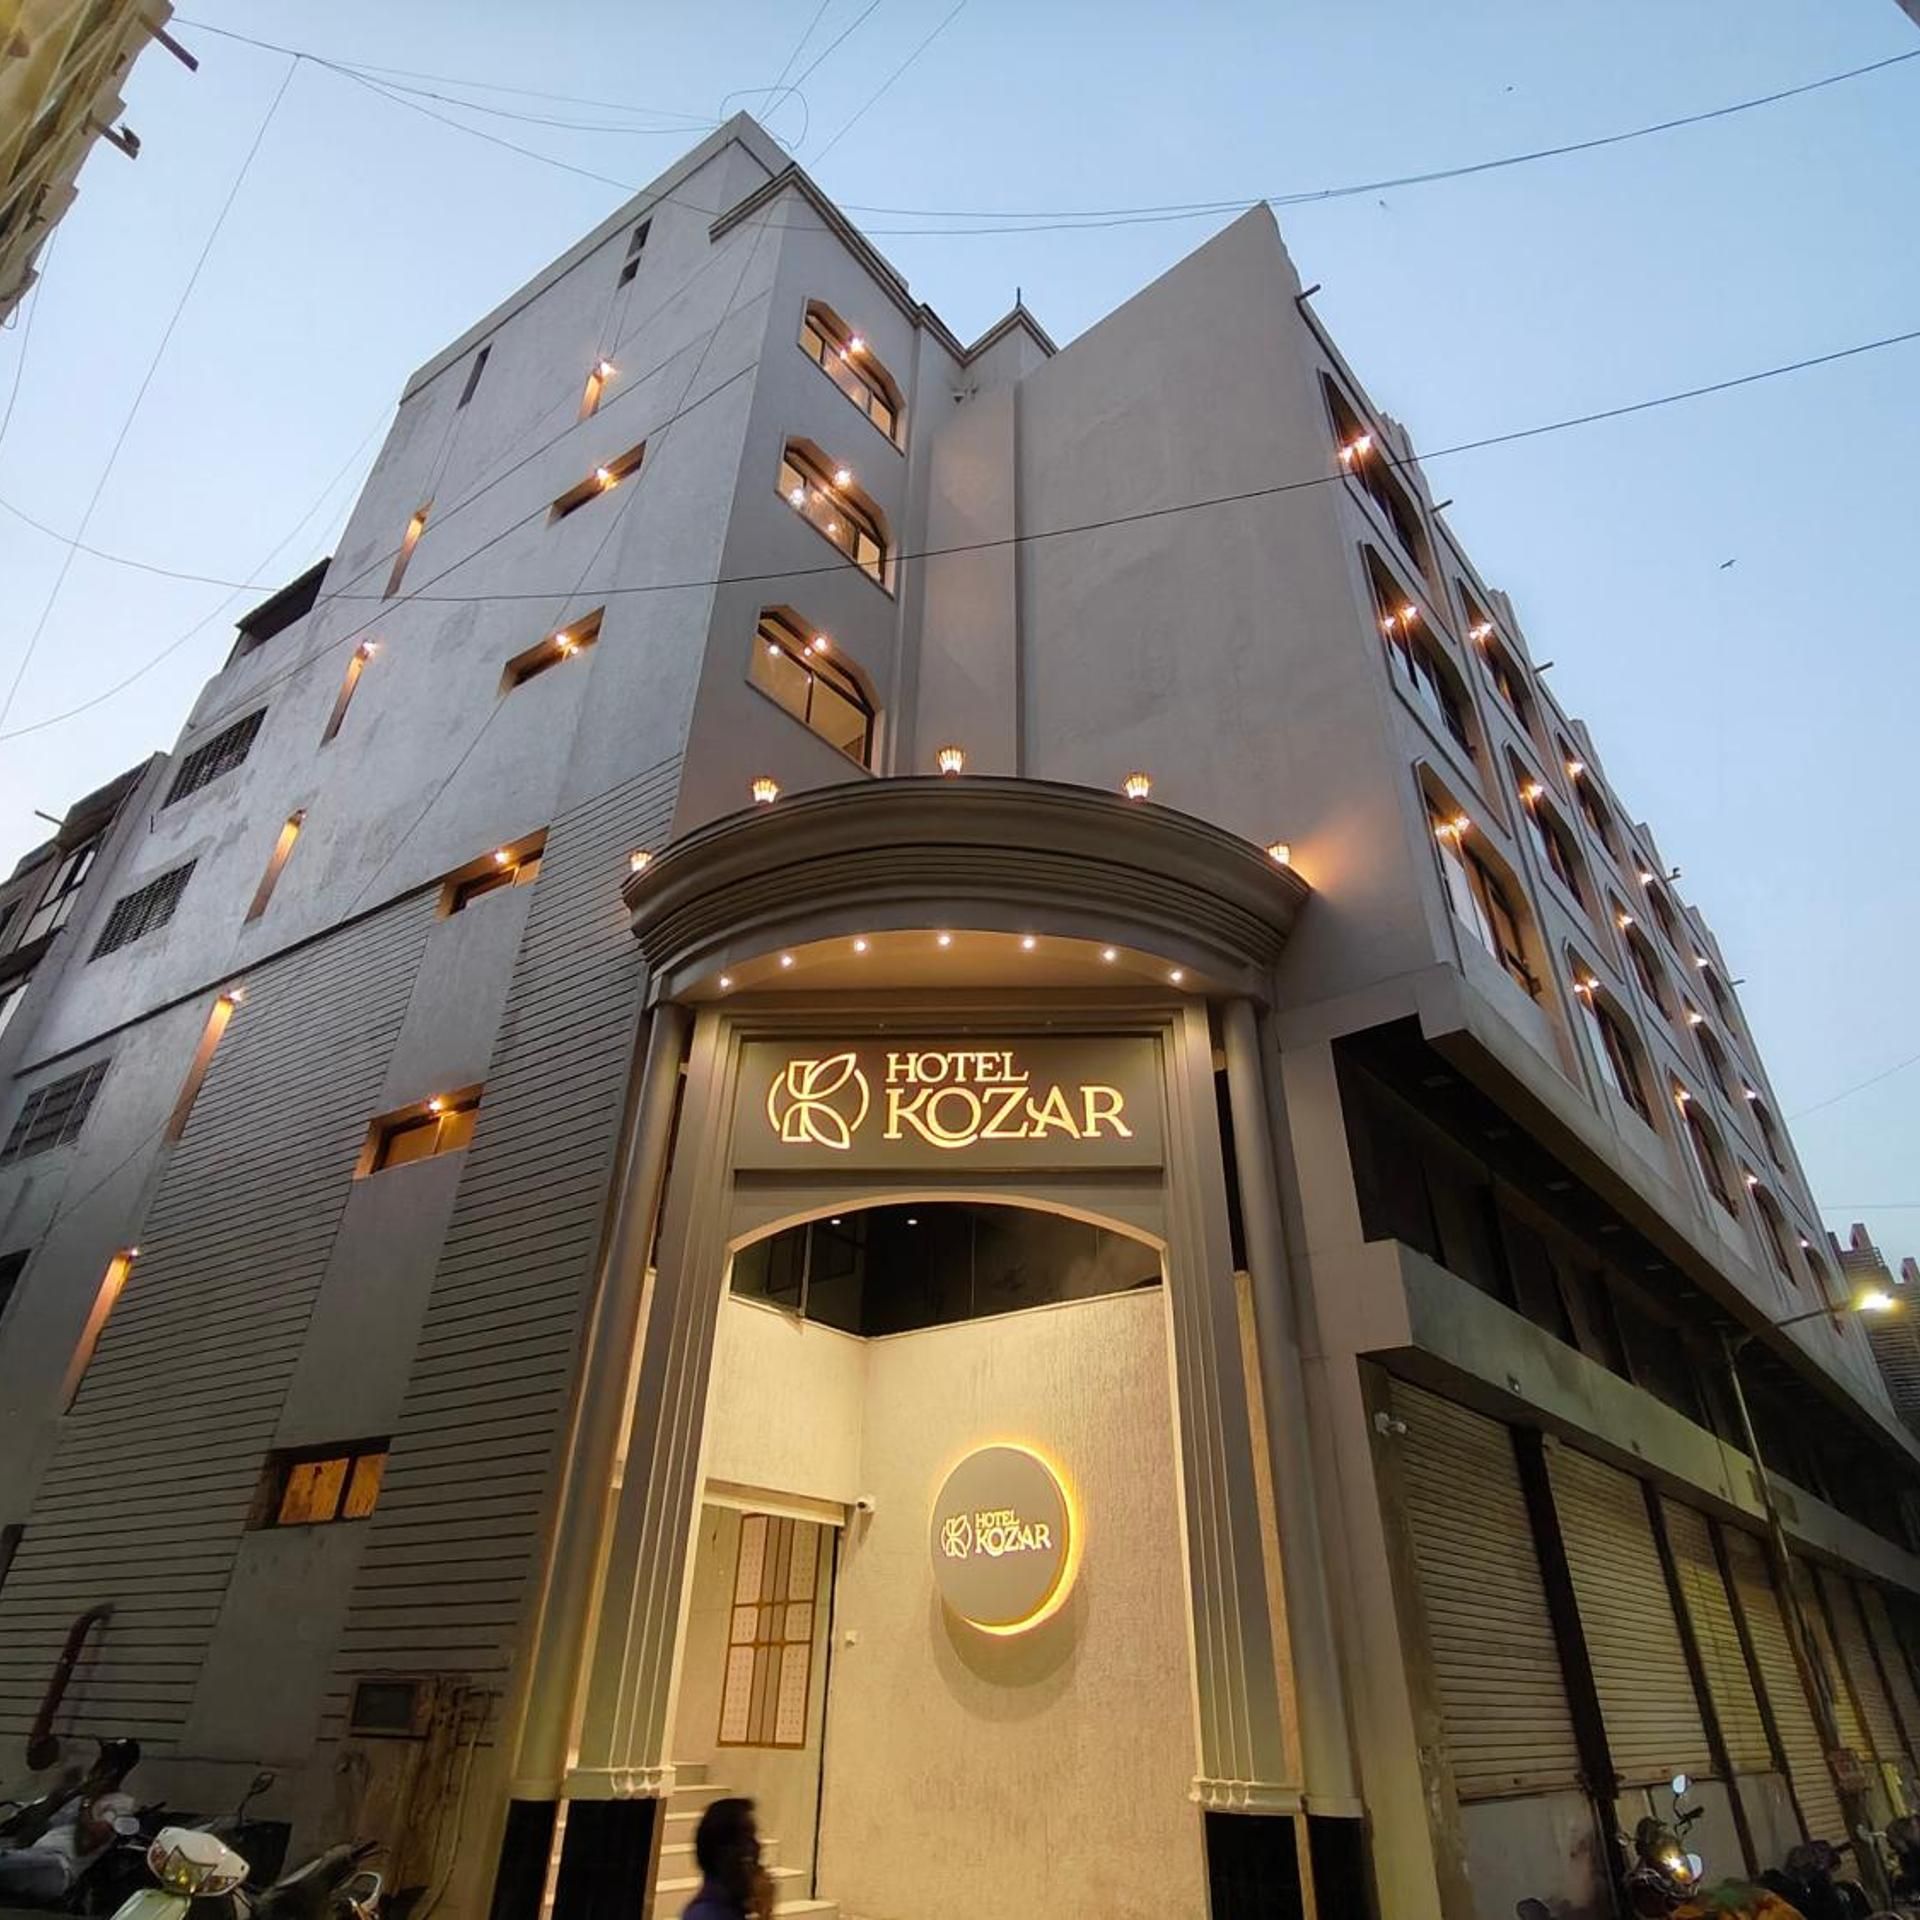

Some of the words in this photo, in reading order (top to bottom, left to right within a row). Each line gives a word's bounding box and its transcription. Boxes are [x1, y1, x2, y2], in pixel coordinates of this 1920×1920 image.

[885, 1052, 1028, 1083] HOTEL
[883, 1085, 1132, 1148] KOZAR
[975, 1510, 1020, 1528] HOTEL
[975, 1524, 1051, 1557] KOZAR
